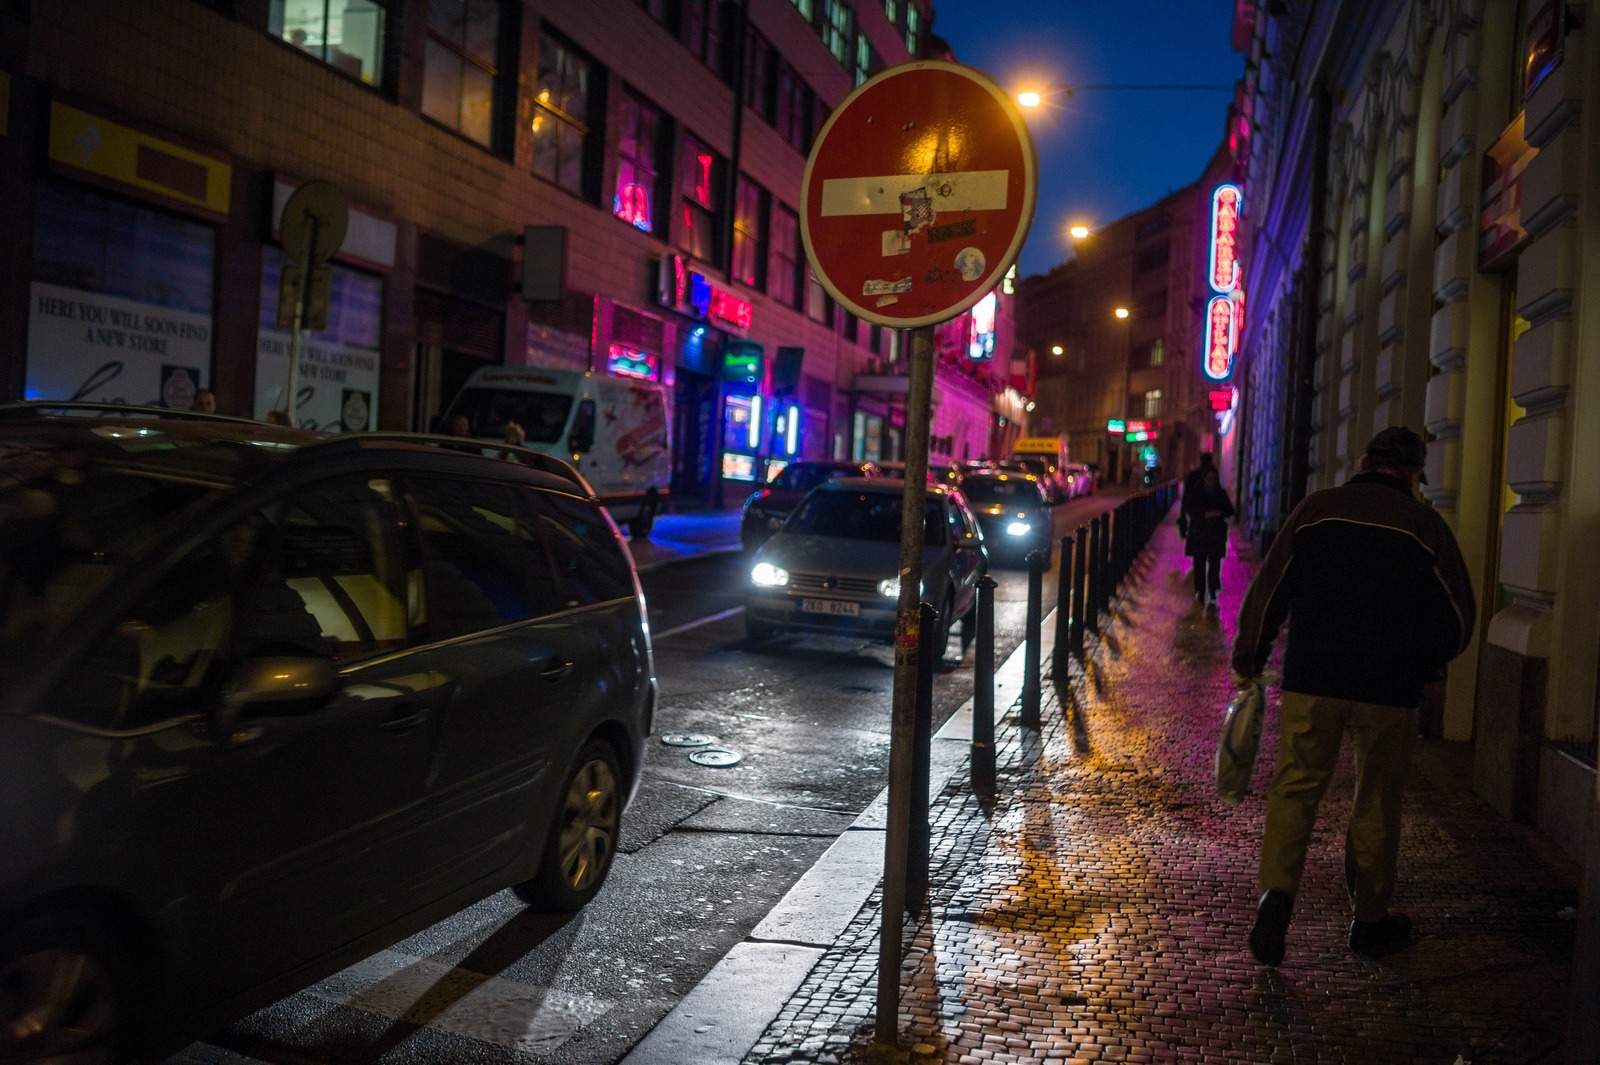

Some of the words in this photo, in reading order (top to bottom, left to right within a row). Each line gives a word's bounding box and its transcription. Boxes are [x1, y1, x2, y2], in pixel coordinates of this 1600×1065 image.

[1215, 189, 1236, 289] CABARET
[38, 296, 75, 319] HERE
[78, 304, 107, 324] YOU
[109, 309, 141, 329] WILL
[144, 316, 177, 335] SOON
[180, 322, 208, 341] FIND
[1210, 300, 1230, 375] ATLAS
[86, 328, 95, 345] A
[96, 328, 125, 347] NEW
[128, 333, 168, 354] STORE
[260, 339, 284, 355] HERE
[307, 347, 329, 364] WILL
[330, 351, 353, 367] SOON
[354, 356, 374, 371] FIND
[300, 364, 317, 378] NEW
[319, 367, 348, 383] STORE
